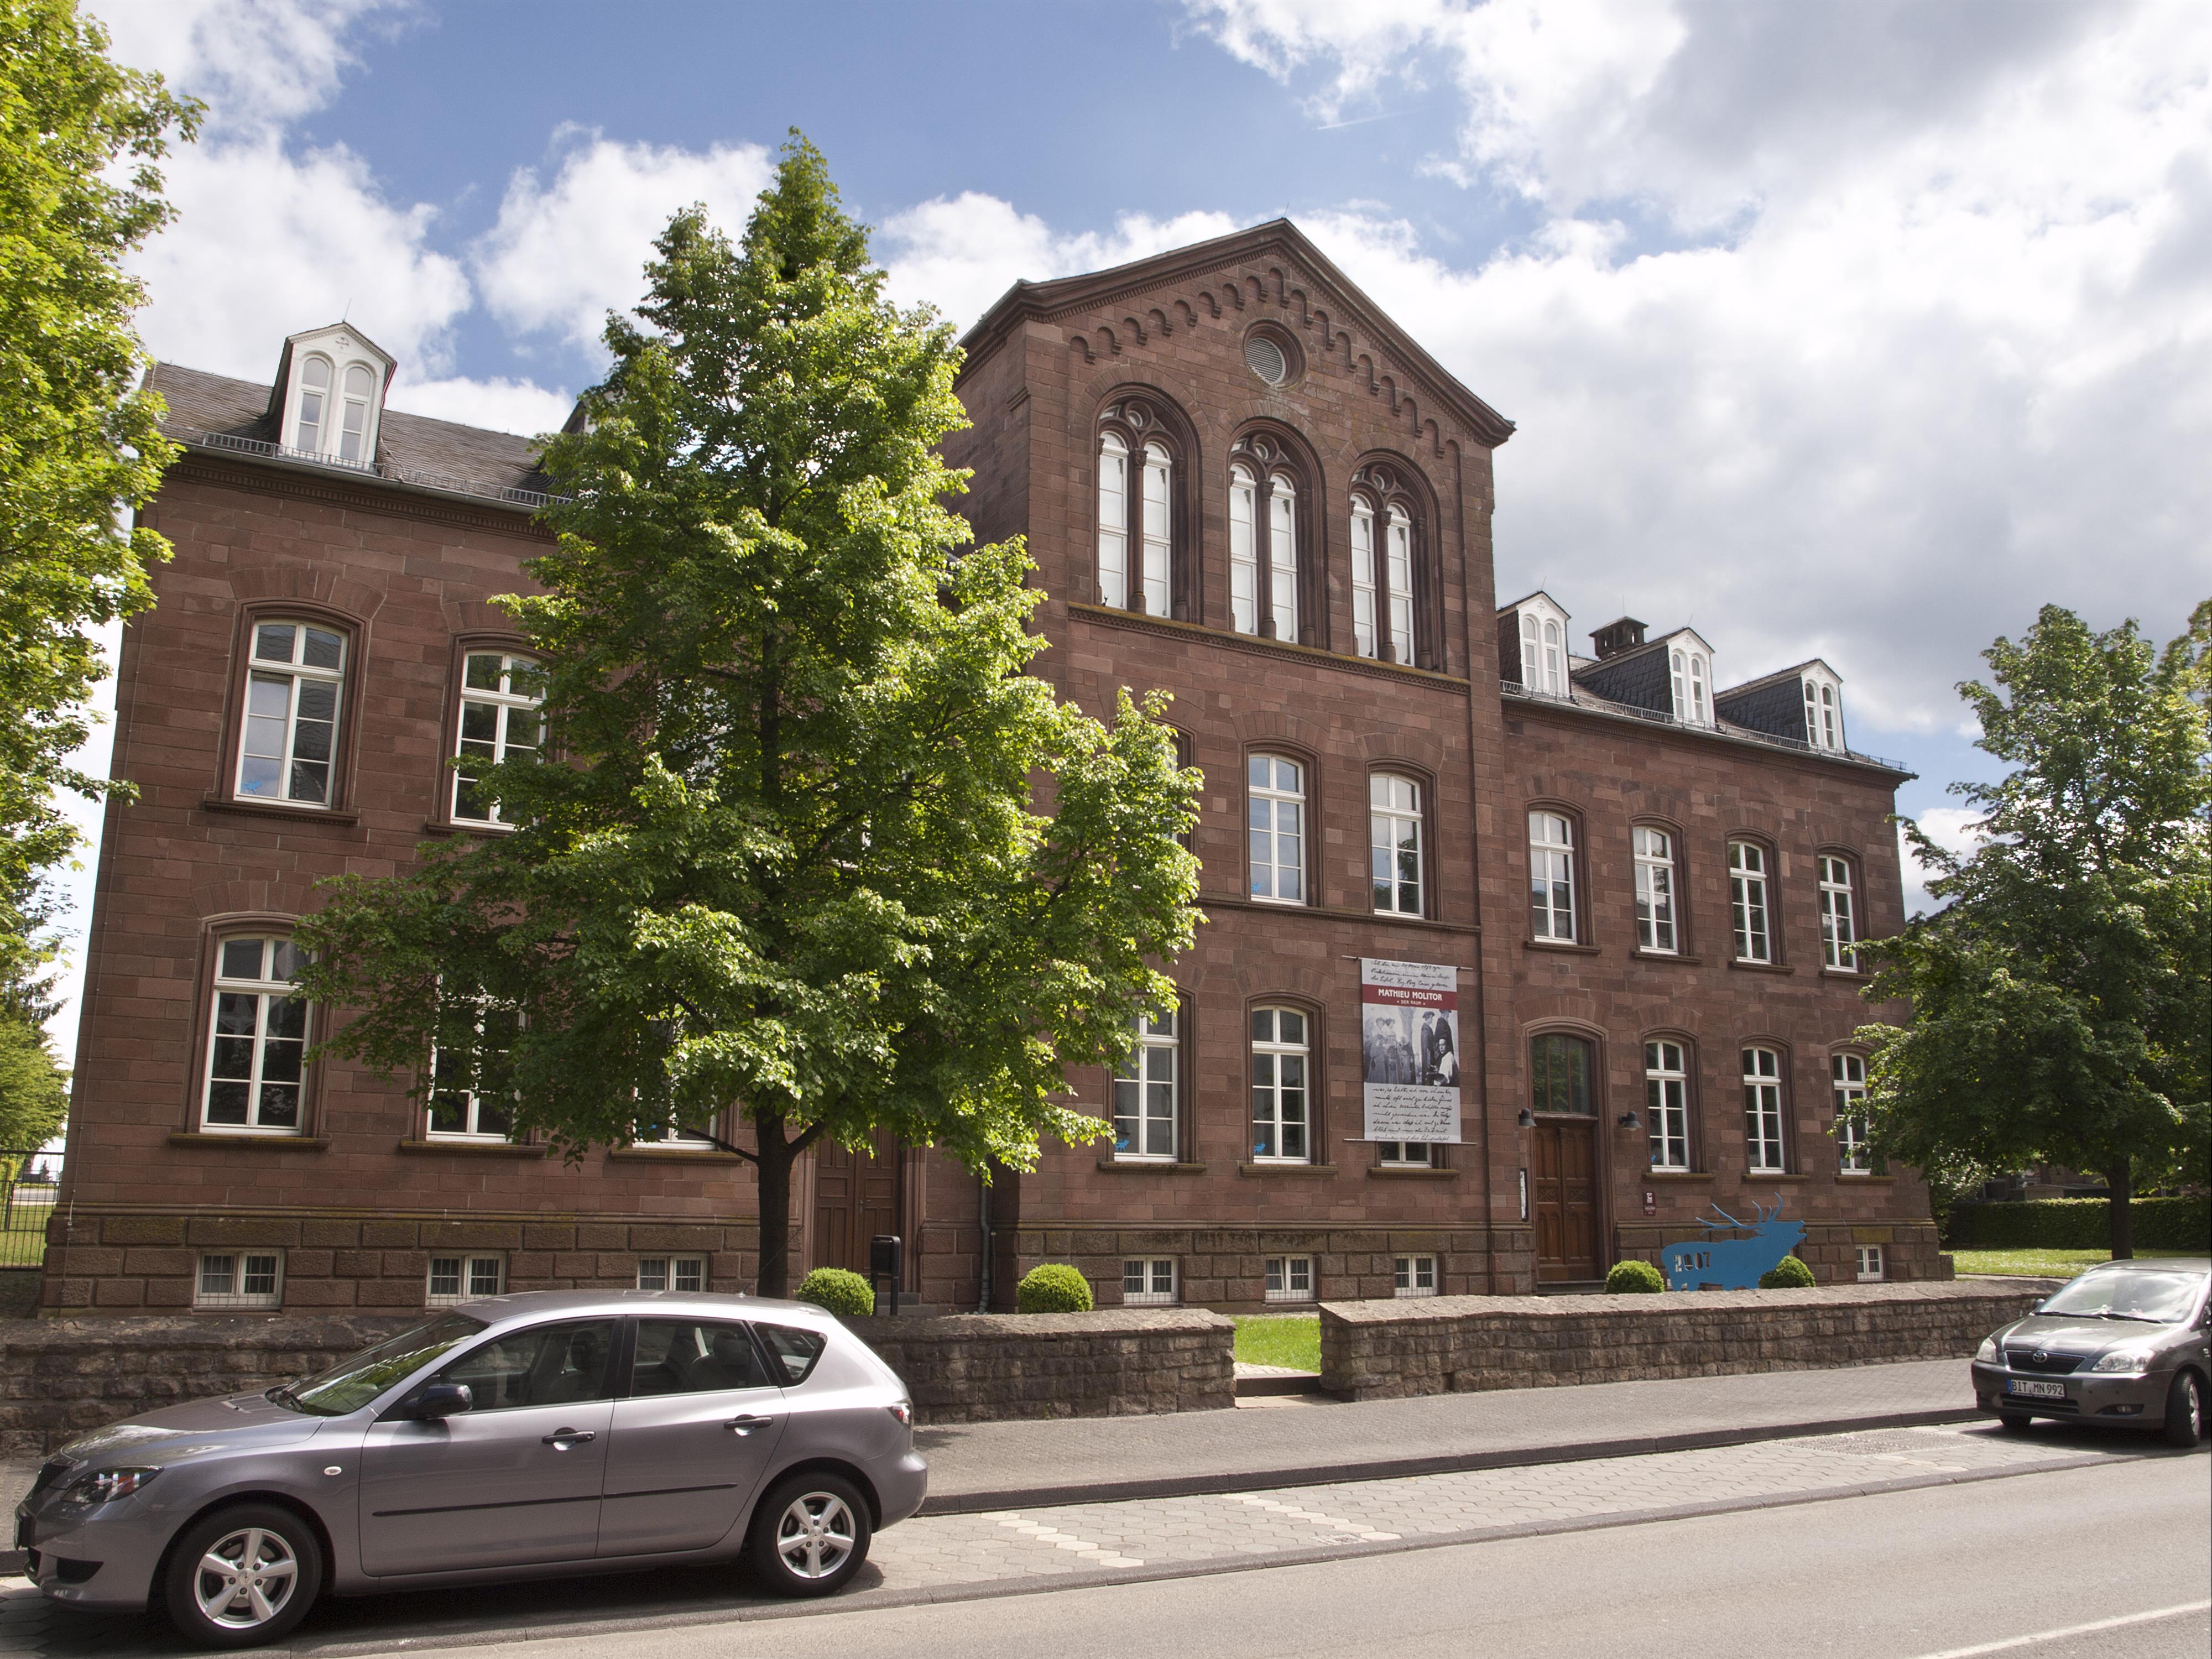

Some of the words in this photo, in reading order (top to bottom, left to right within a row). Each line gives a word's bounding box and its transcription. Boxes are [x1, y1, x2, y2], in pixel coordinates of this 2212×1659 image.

[1378, 988, 1410, 998] MATHIEU
[1412, 991, 1443, 1001] MOLITOR
[1673, 1251, 1711, 1272] 2007
[2012, 1381, 2027, 1392] BIT
[2033, 1383, 2045, 1394] MN
[2046, 1384, 2063, 1395] 992
